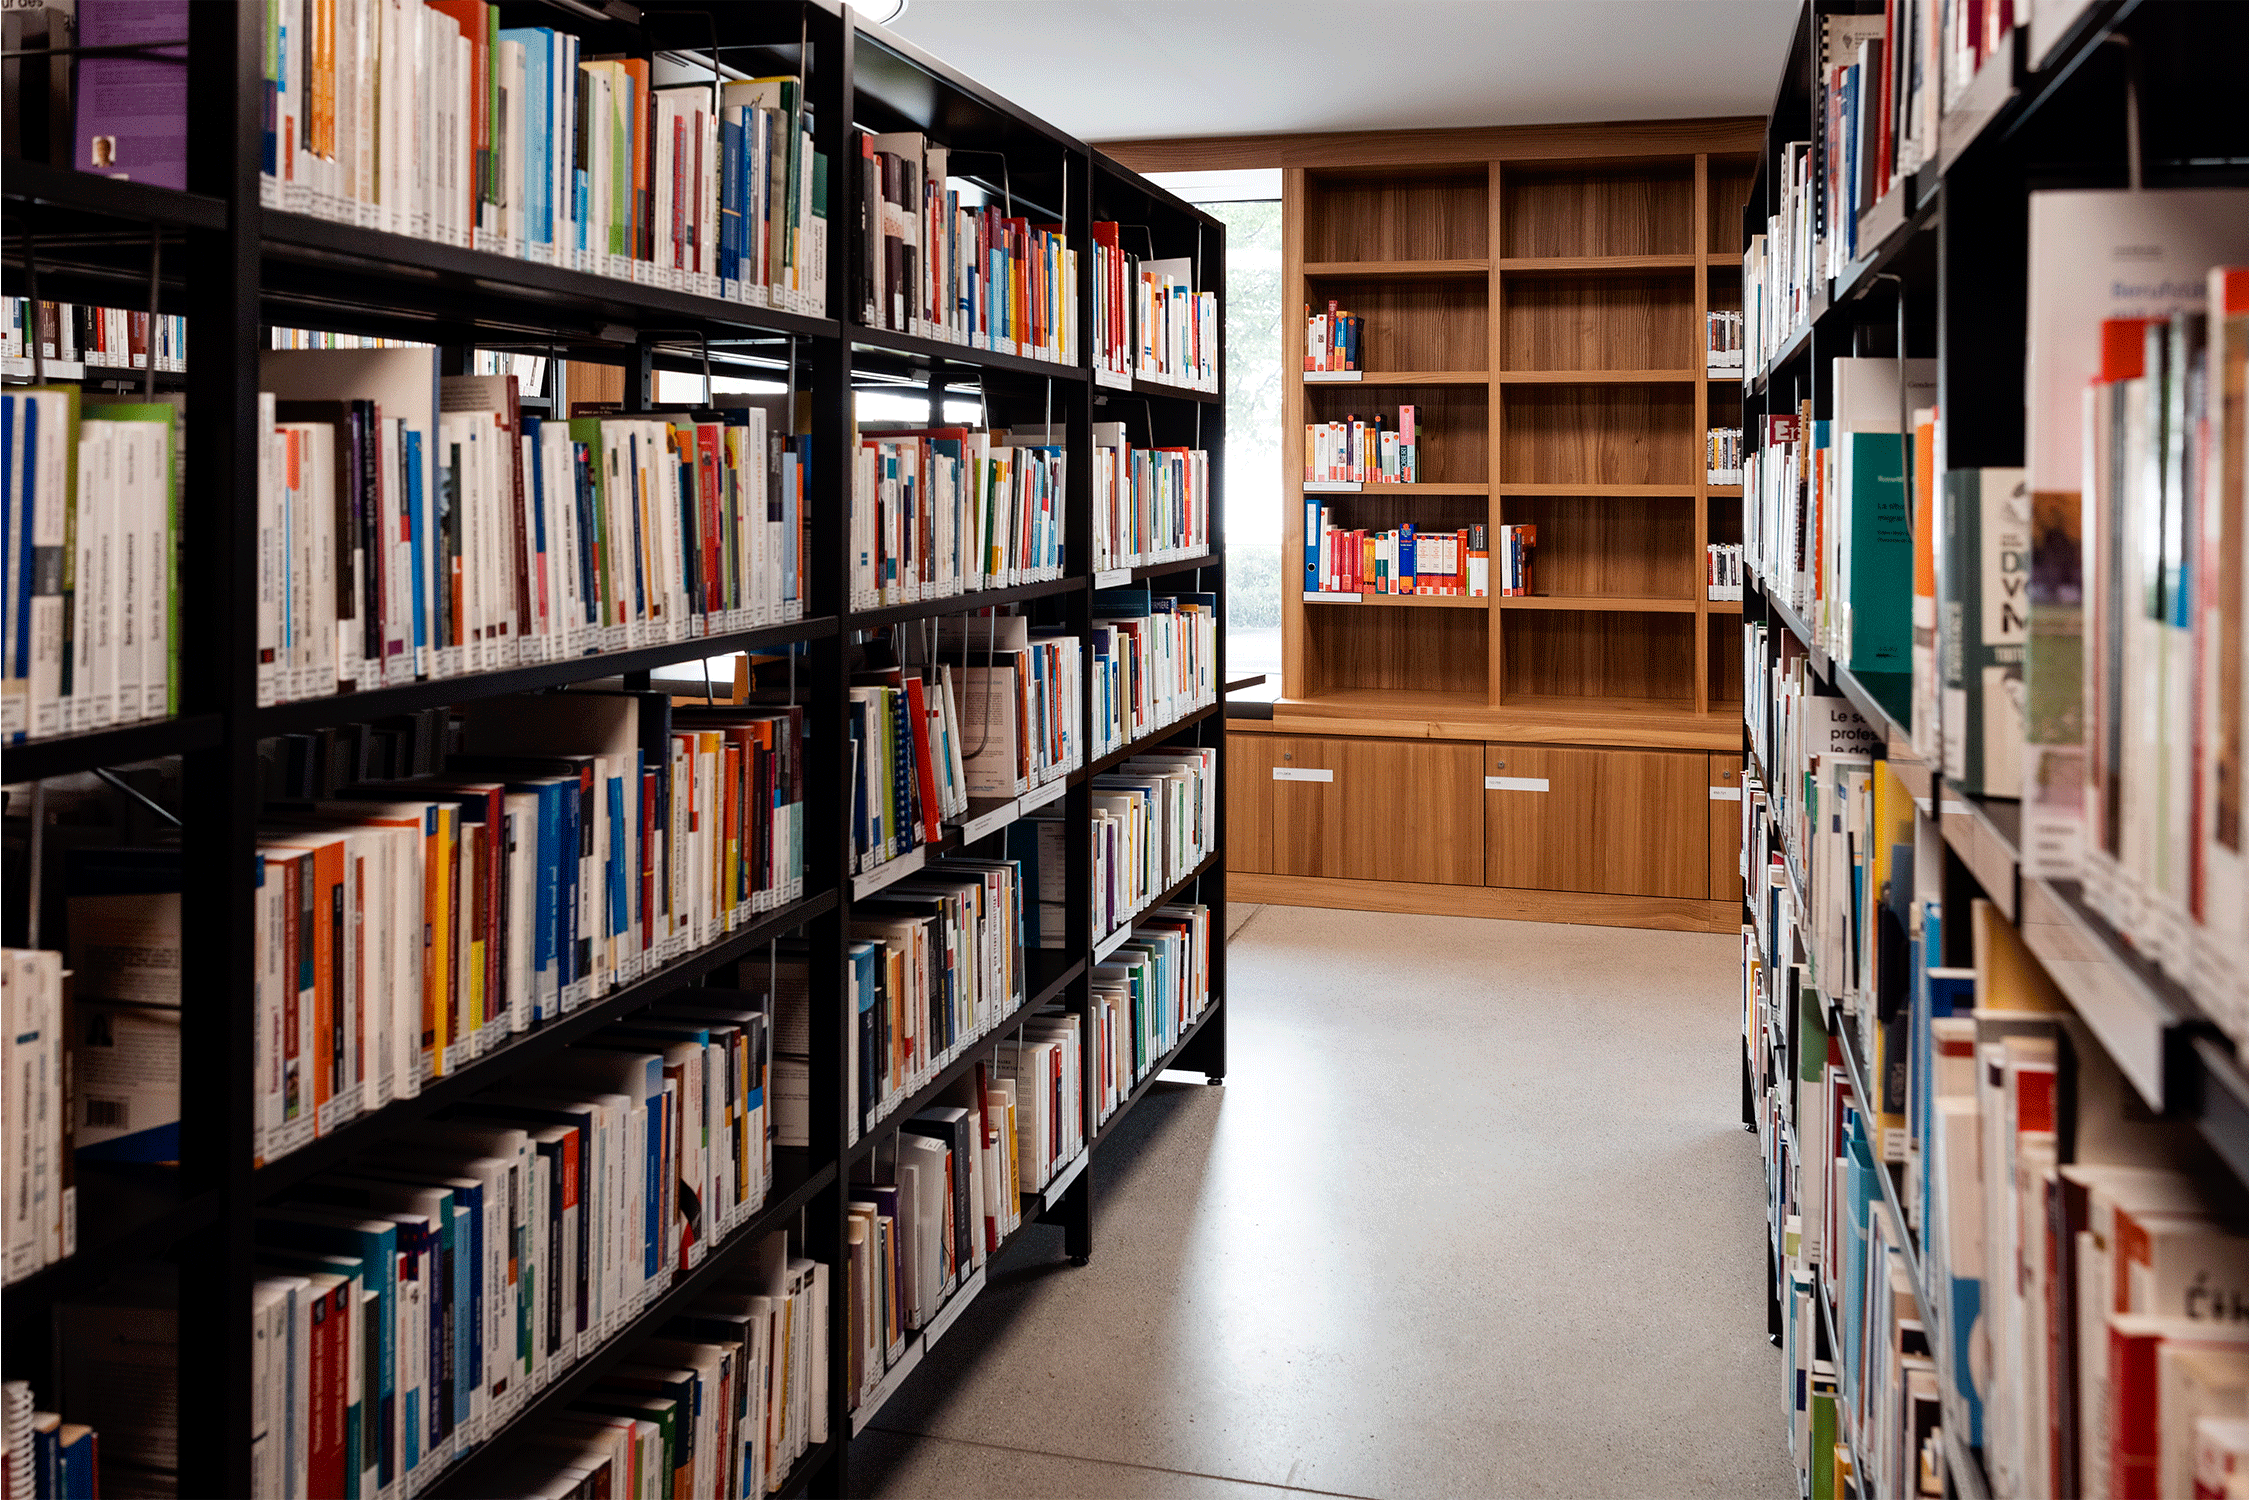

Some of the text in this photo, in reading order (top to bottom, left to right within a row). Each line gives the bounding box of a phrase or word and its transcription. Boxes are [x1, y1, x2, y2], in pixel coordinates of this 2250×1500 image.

[365, 430, 377, 527] Social Work
[669, 459, 678, 518] supervision
[1831, 710, 1848, 722] Le
[547, 865, 557, 882] social
[547, 884, 557, 906] travail
[546, 918, 556, 957] Introduction
